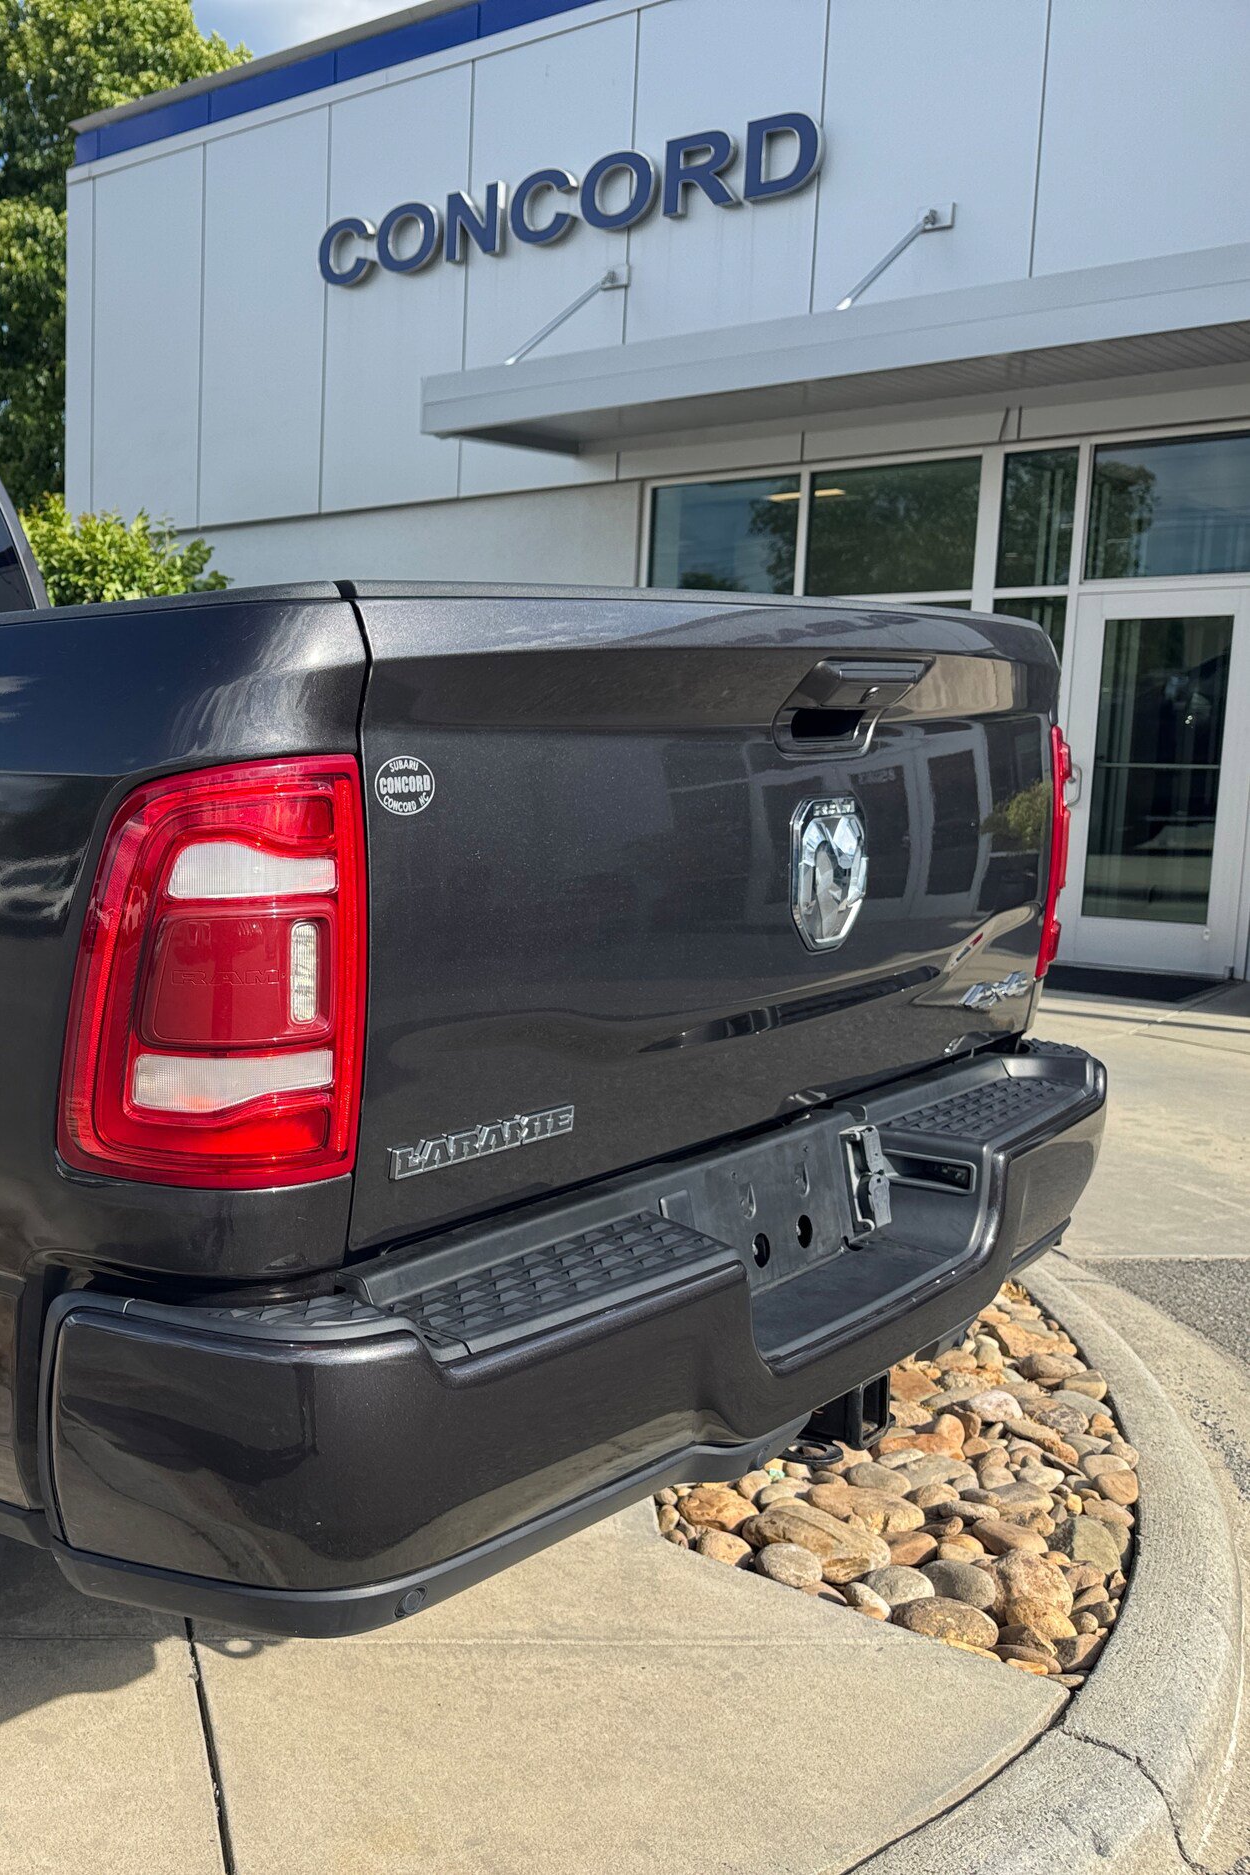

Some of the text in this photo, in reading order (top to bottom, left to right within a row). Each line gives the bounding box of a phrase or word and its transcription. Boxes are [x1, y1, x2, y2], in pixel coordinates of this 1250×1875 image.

[318, 111, 825, 286] CONCORD
[389, 759, 419, 773] SUBARU
[379, 774, 431, 795] CONCORD
[383, 791, 430, 812] CONCORD NC
[171, 969, 279, 985] RAM
[388, 1104, 575, 1181] LARAMIE
